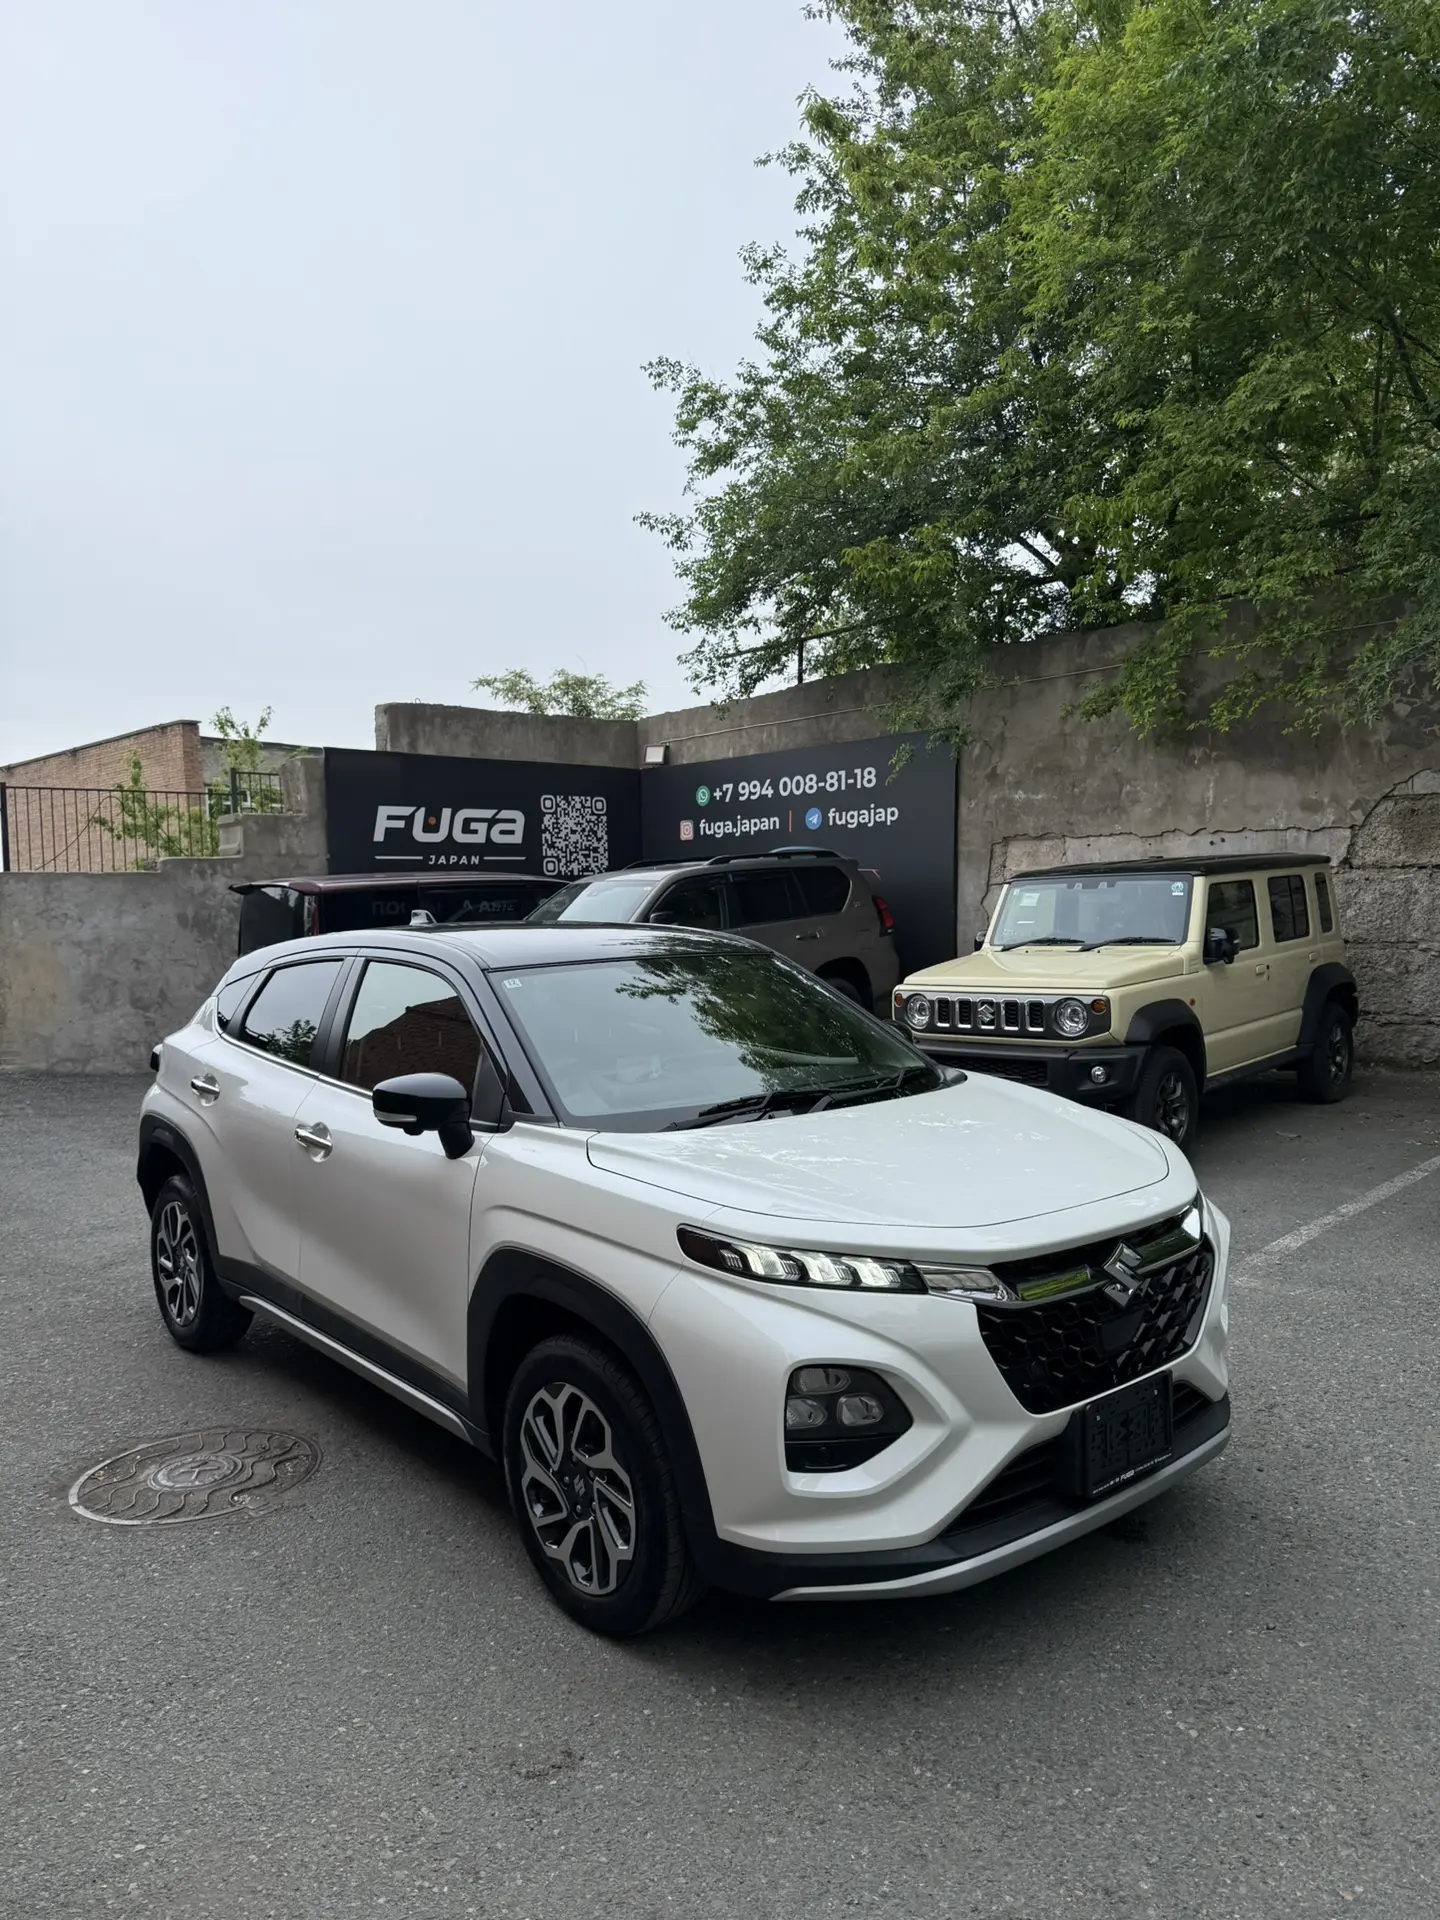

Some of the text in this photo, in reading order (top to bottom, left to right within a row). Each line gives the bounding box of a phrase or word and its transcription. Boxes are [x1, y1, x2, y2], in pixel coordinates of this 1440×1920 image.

[713, 767, 877, 803] +7 994 008-81-18
[699, 816, 780, 838] fuga.japan
[828, 803, 899, 828] fugajap
[428, 855, 479, 865] JAPAN
